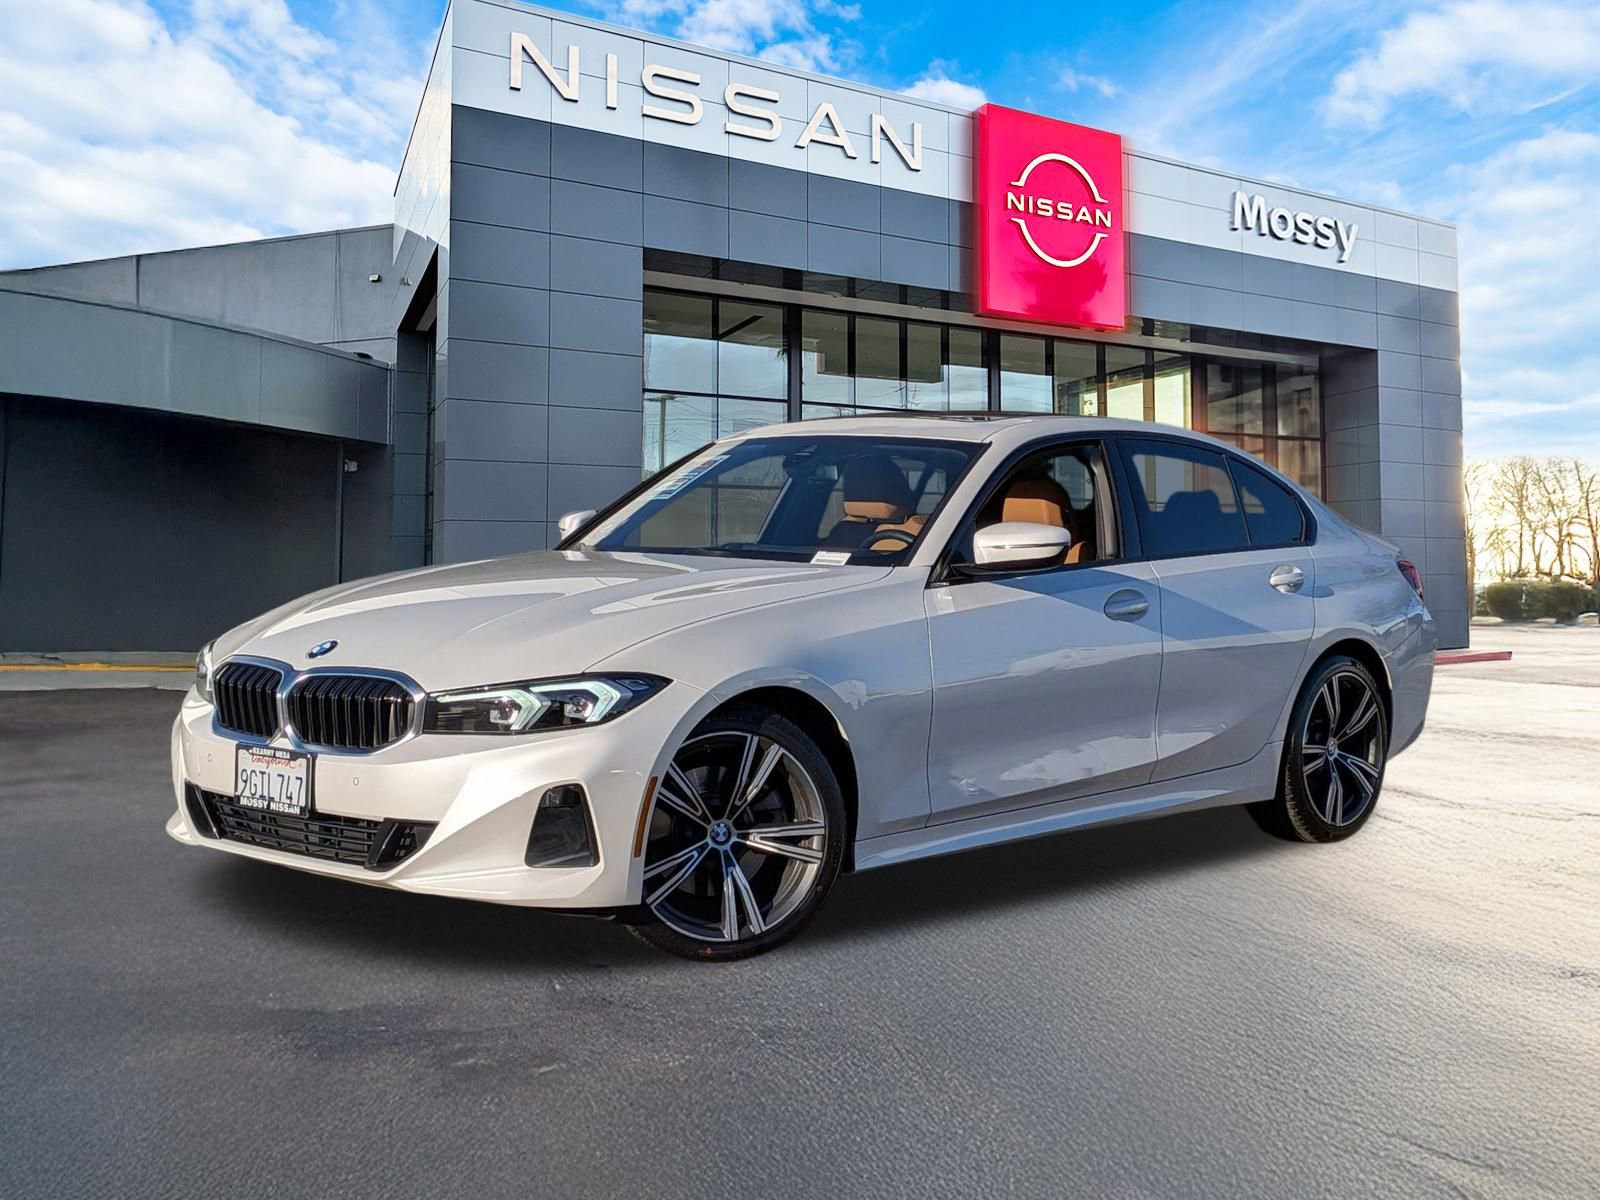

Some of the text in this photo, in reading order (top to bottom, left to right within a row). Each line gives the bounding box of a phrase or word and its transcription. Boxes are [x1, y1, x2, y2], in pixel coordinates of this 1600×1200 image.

[509, 31, 922, 171] NISSAN
[1006, 191, 1112, 228] NISSAN
[1231, 190, 1359, 263] Mossy
[240, 768, 303, 806] 9GIL747
[240, 796, 300, 814] MOSSY NISSAN
